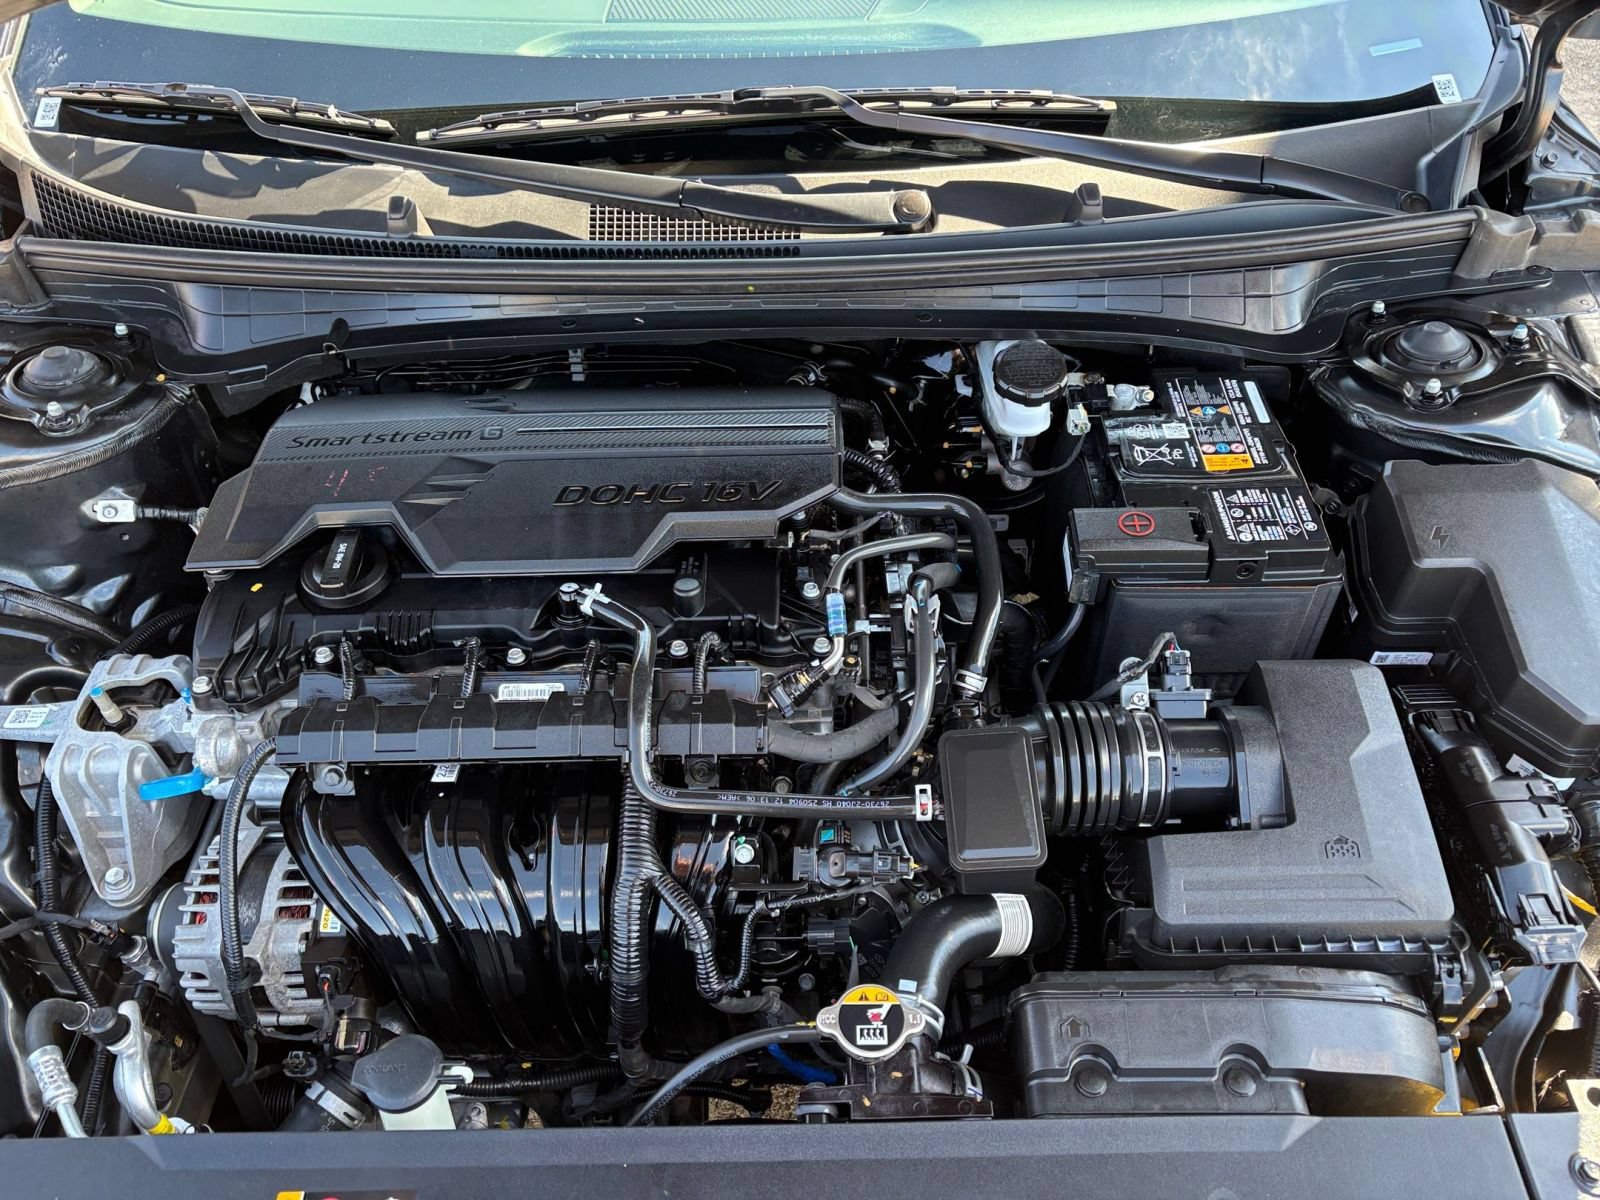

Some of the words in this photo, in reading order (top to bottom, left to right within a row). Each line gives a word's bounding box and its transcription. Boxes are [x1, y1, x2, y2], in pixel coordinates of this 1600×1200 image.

[286, 428, 474, 449] Smartstream
[1172, 448, 1184, 460] Pb
[552, 482, 692, 506] DOHC
[701, 480, 784, 502] 16V
